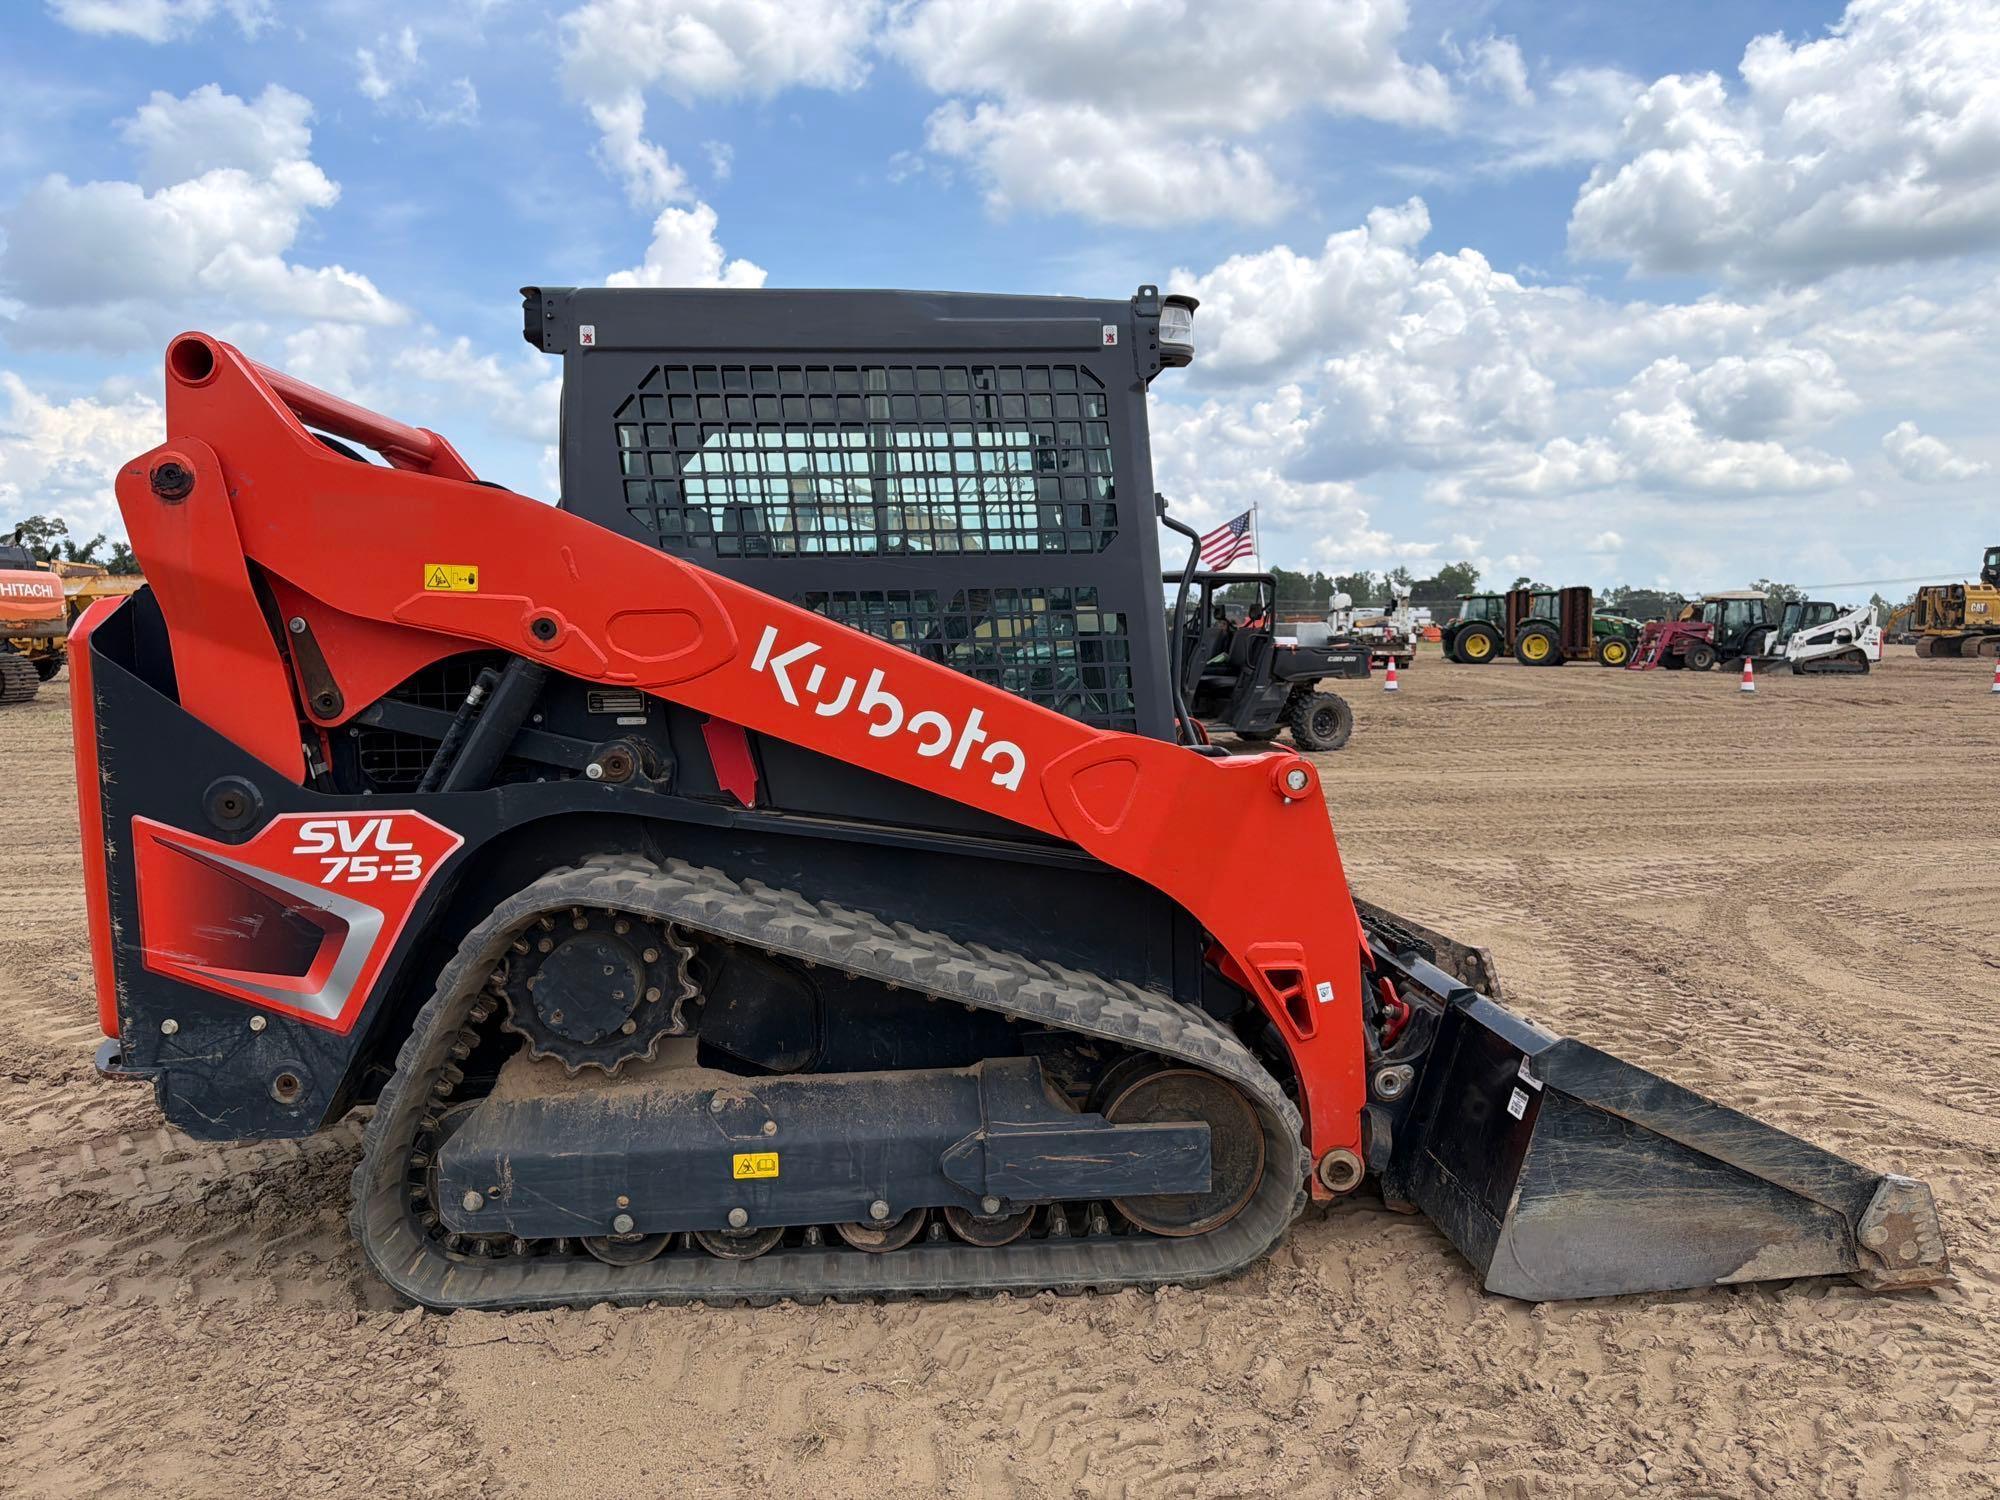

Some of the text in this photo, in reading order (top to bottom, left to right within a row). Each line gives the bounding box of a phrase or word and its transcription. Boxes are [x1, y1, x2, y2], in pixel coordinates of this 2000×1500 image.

[0, 583, 54, 598] HITACHI
[1970, 602, 1985, 612] CAT
[751, 625, 1026, 791] Kubota
[292, 819, 413, 854] SVL
[320, 855, 422, 884] 75-3
